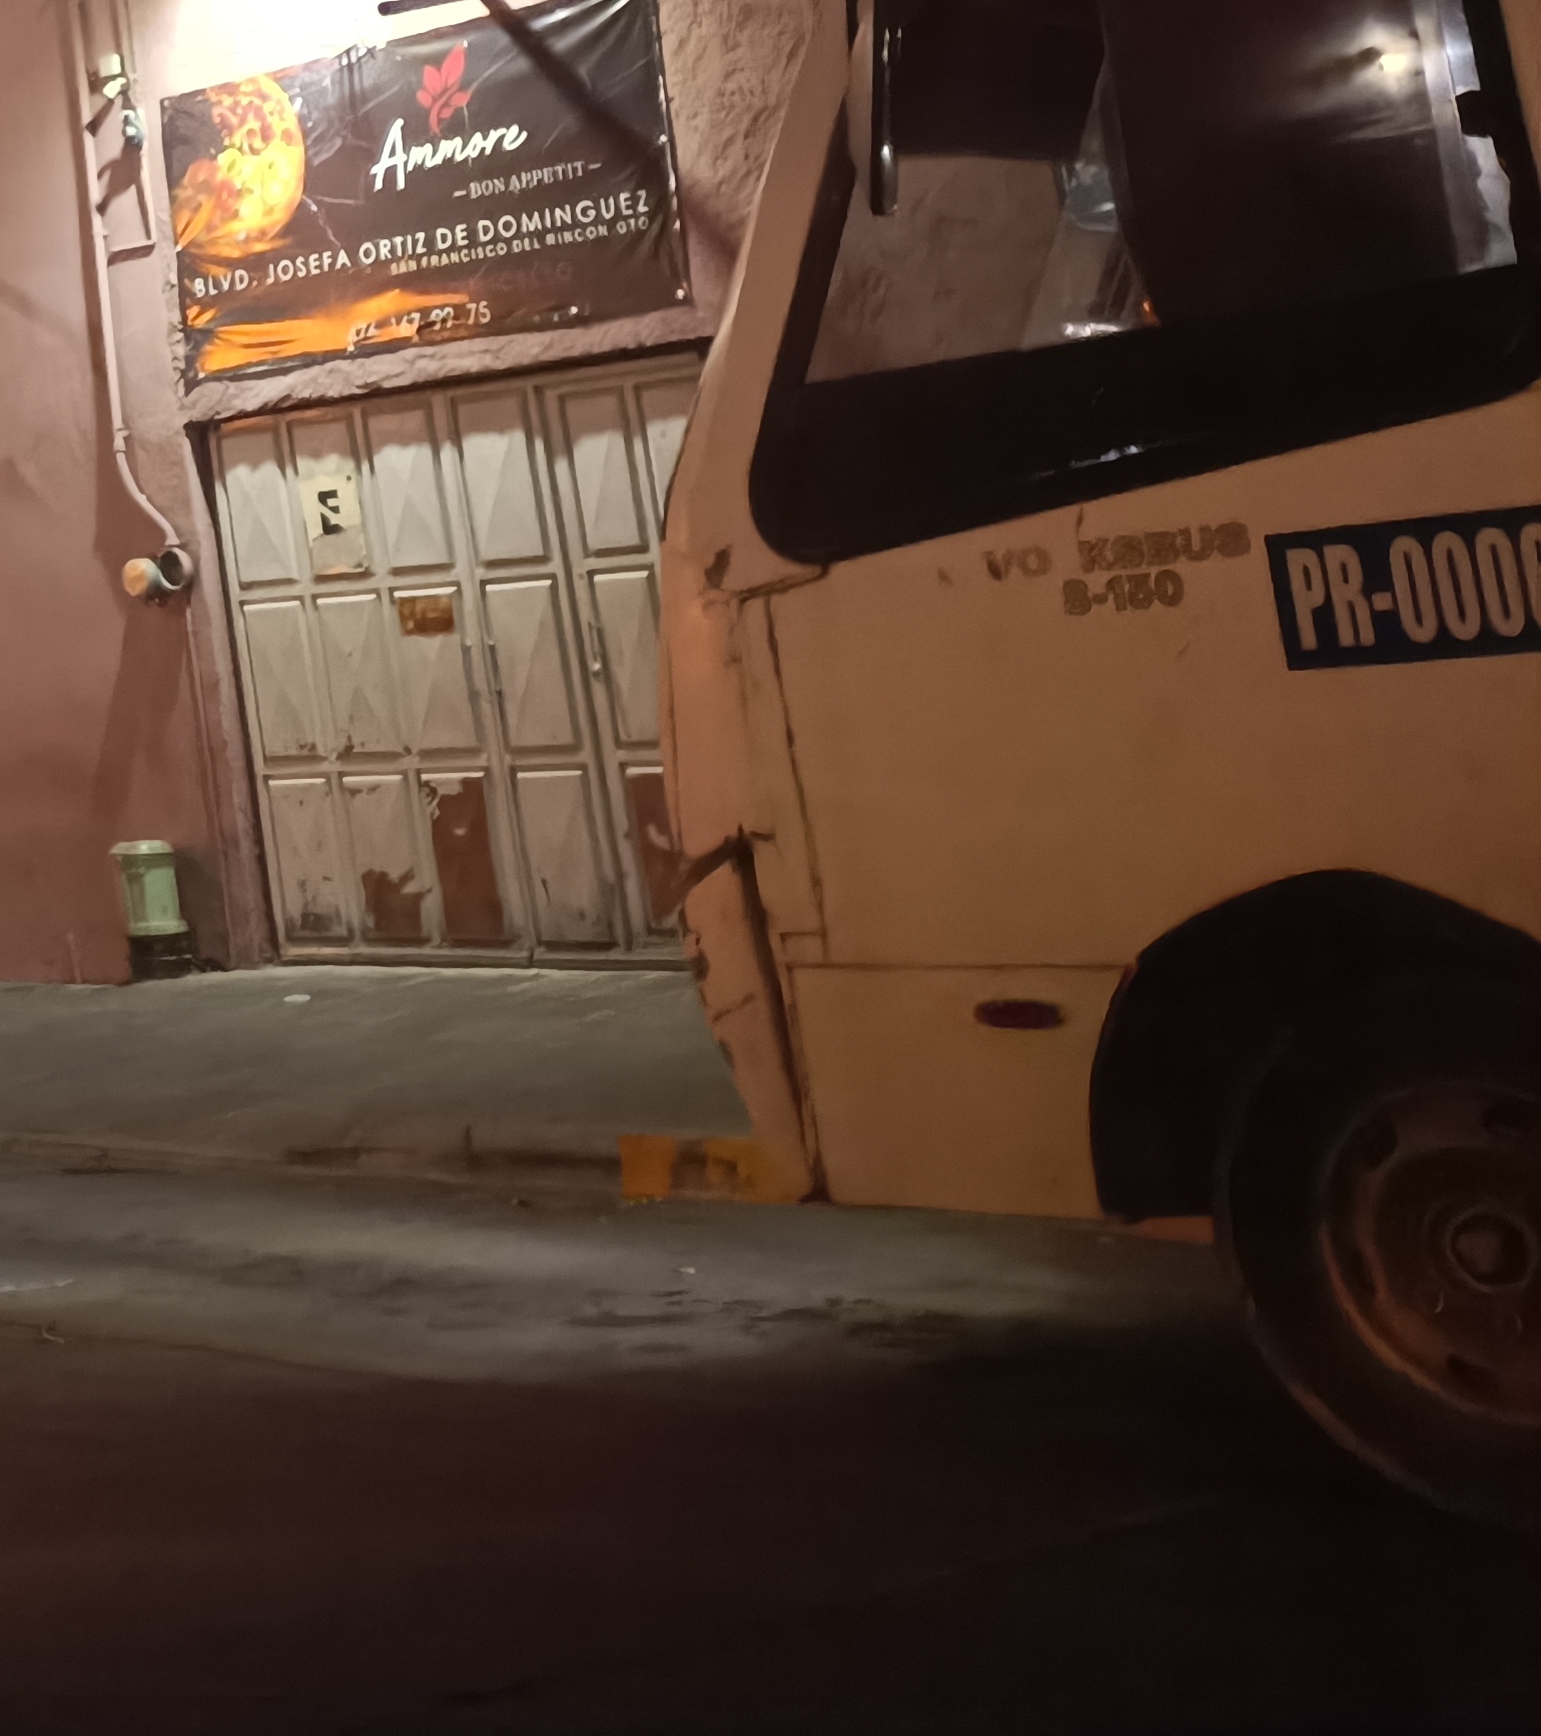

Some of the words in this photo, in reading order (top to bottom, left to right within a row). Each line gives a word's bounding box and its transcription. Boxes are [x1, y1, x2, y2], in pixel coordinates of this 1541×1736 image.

[370, 118, 528, 192] Ammore
[193, 269, 257, 298] BLVD.
[267, 249, 351, 285] JOSEFA
[358, 231, 427, 264] ORTIZ
[436, 223, 469, 249] DE
[477, 189, 649, 242] DOMINGUEZ
[420, 241, 507, 269] FRANCISCO
[512, 235, 541, 253] DEL
